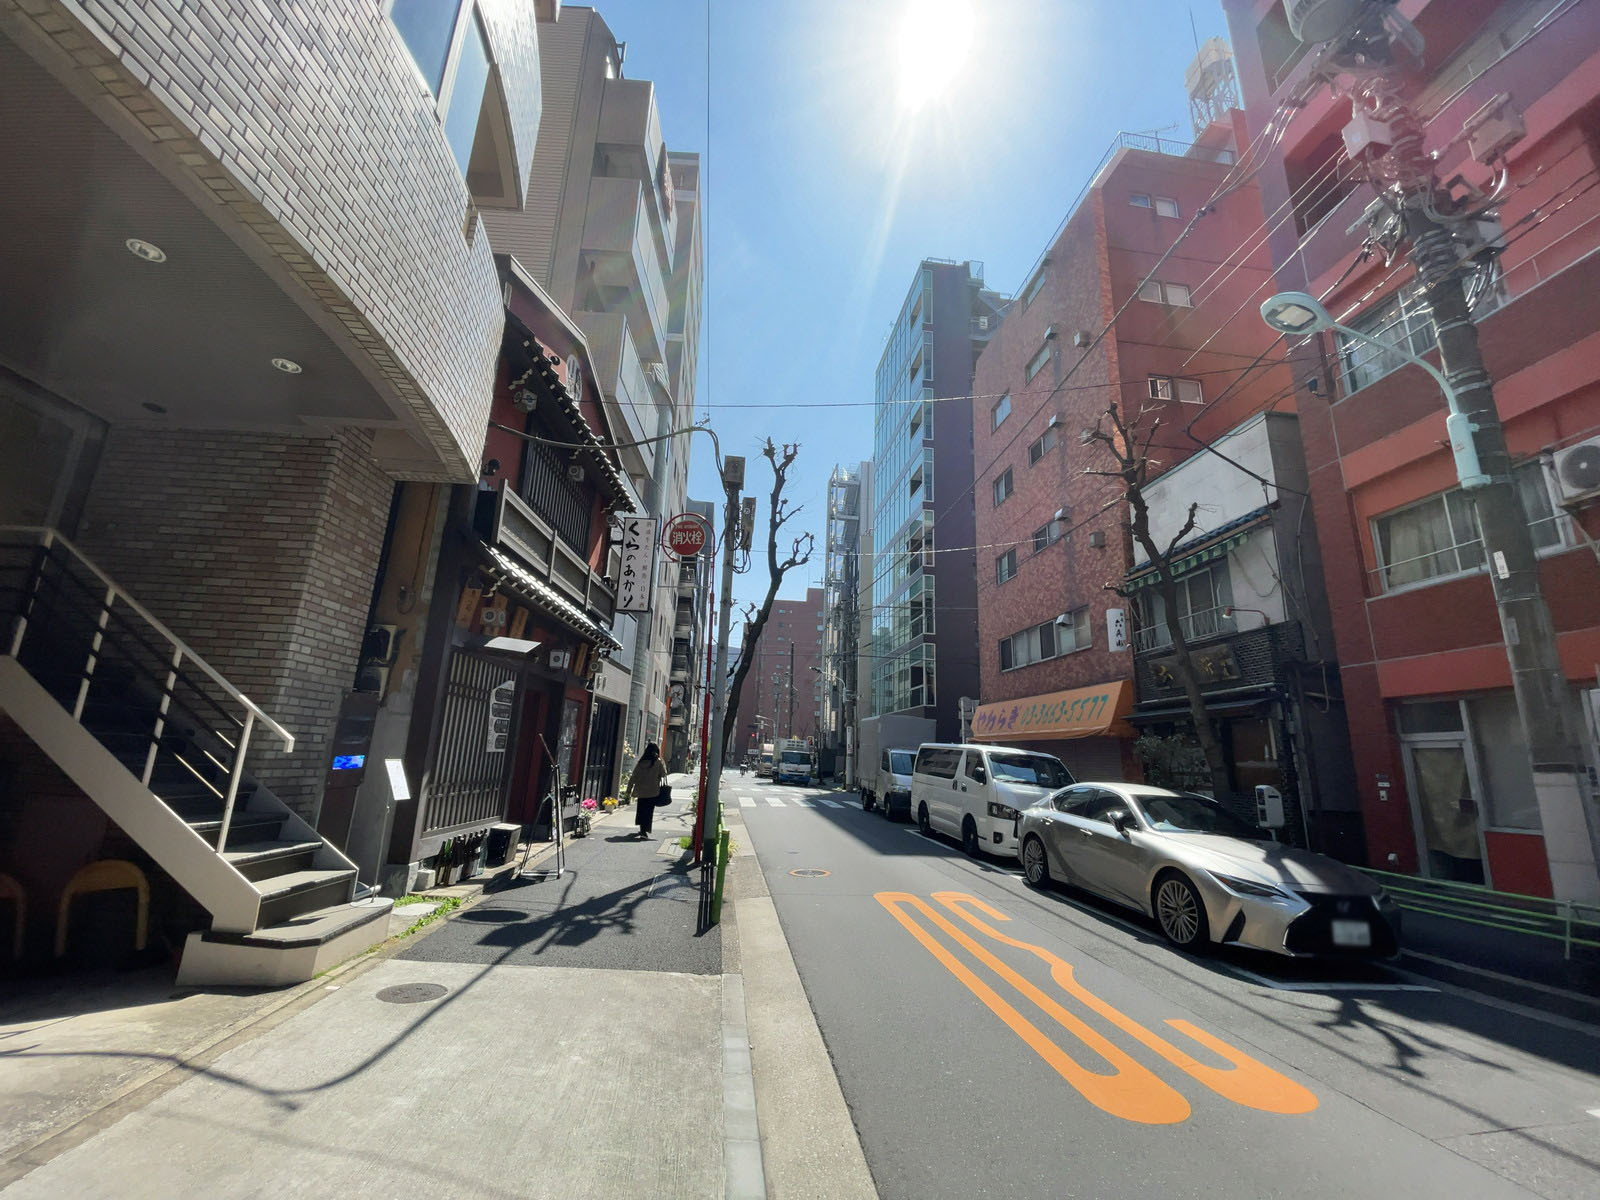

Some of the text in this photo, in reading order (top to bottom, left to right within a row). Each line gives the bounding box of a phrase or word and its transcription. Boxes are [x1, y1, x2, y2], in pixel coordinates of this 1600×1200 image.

[672, 531, 702, 545] 消火栓
[623, 520, 640, 608] くらのあかり
